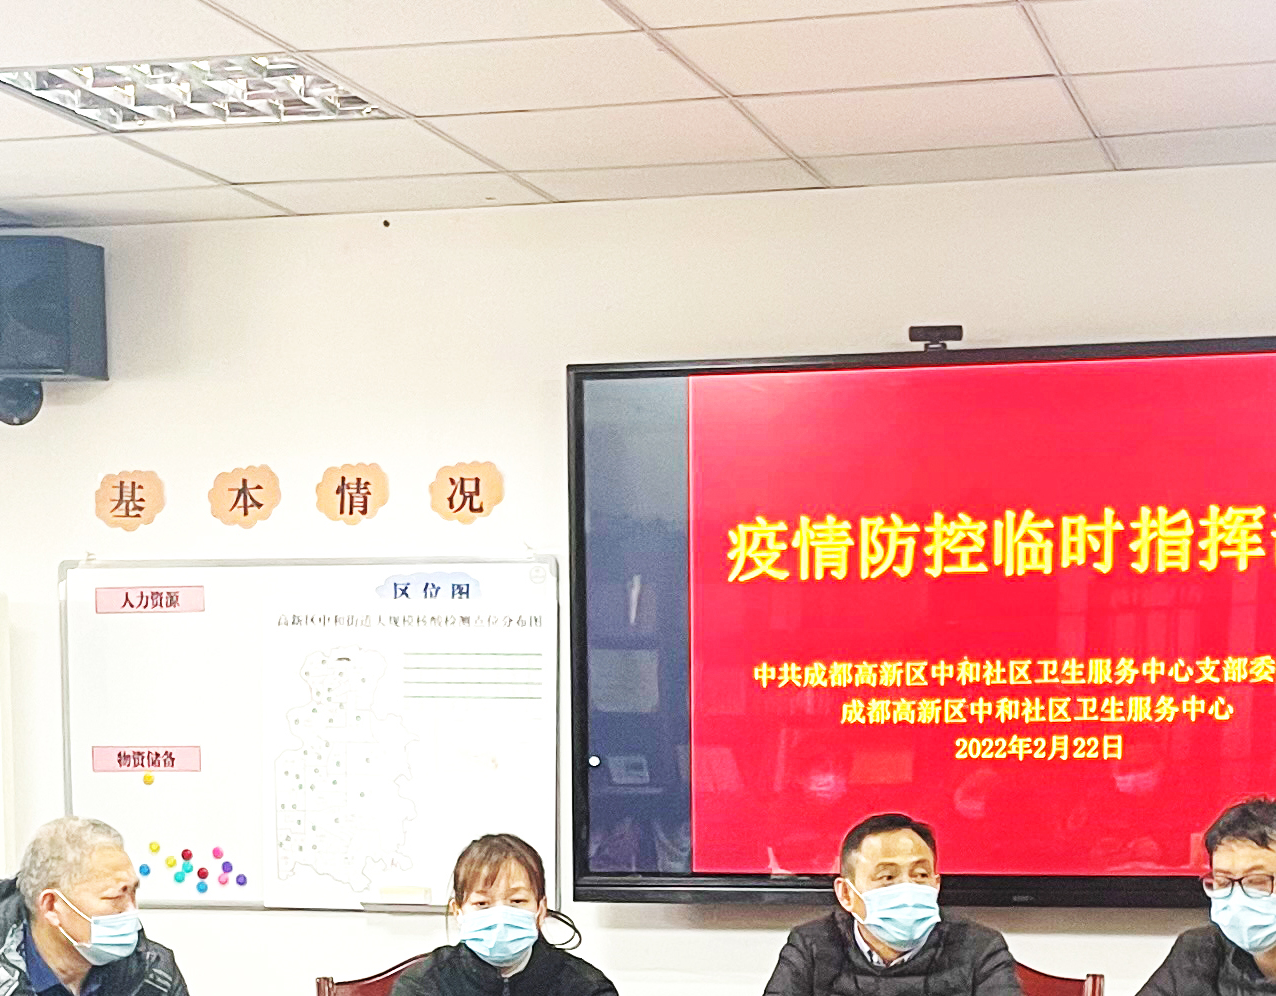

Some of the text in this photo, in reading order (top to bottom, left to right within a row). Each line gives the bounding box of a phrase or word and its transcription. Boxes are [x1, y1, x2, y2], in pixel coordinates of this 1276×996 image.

[108, 475, 484, 519] 基本情况
[120, 590, 181, 610] 人力资源
[392, 582, 471, 600] 区位图
[840, 697, 1235, 726] 成都高新区中和社区卫生服务中心
[116, 750, 177, 769] 物资储备
[954, 734, 1125, 762] 2022年2月22日
